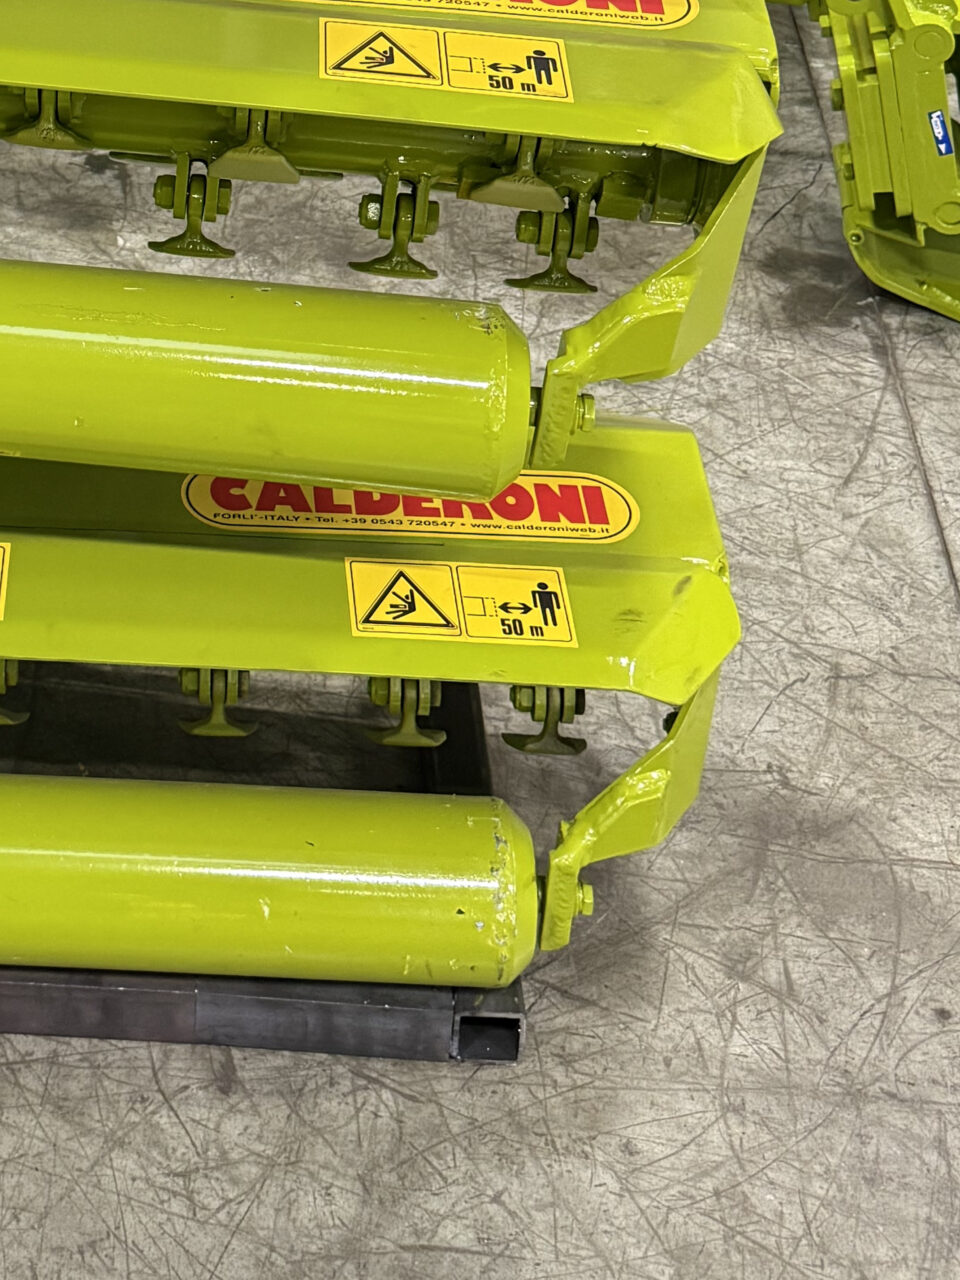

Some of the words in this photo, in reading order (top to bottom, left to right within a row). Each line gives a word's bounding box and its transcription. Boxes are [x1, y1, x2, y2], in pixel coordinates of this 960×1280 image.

[507, 4, 664, 23] www.calderoniweb.it
[488, 75, 515, 91] 50
[520, 82, 537, 93] m
[315, 515, 337, 524] Tel.
[342, 517, 367, 525] +39
[371, 518, 403, 526] 0543
[407, 519, 455, 528] 720547
[471, 522, 610, 534] www.calderoniweb.it
[500, 618, 524, 637] 50
[530, 625, 545, 638] m
